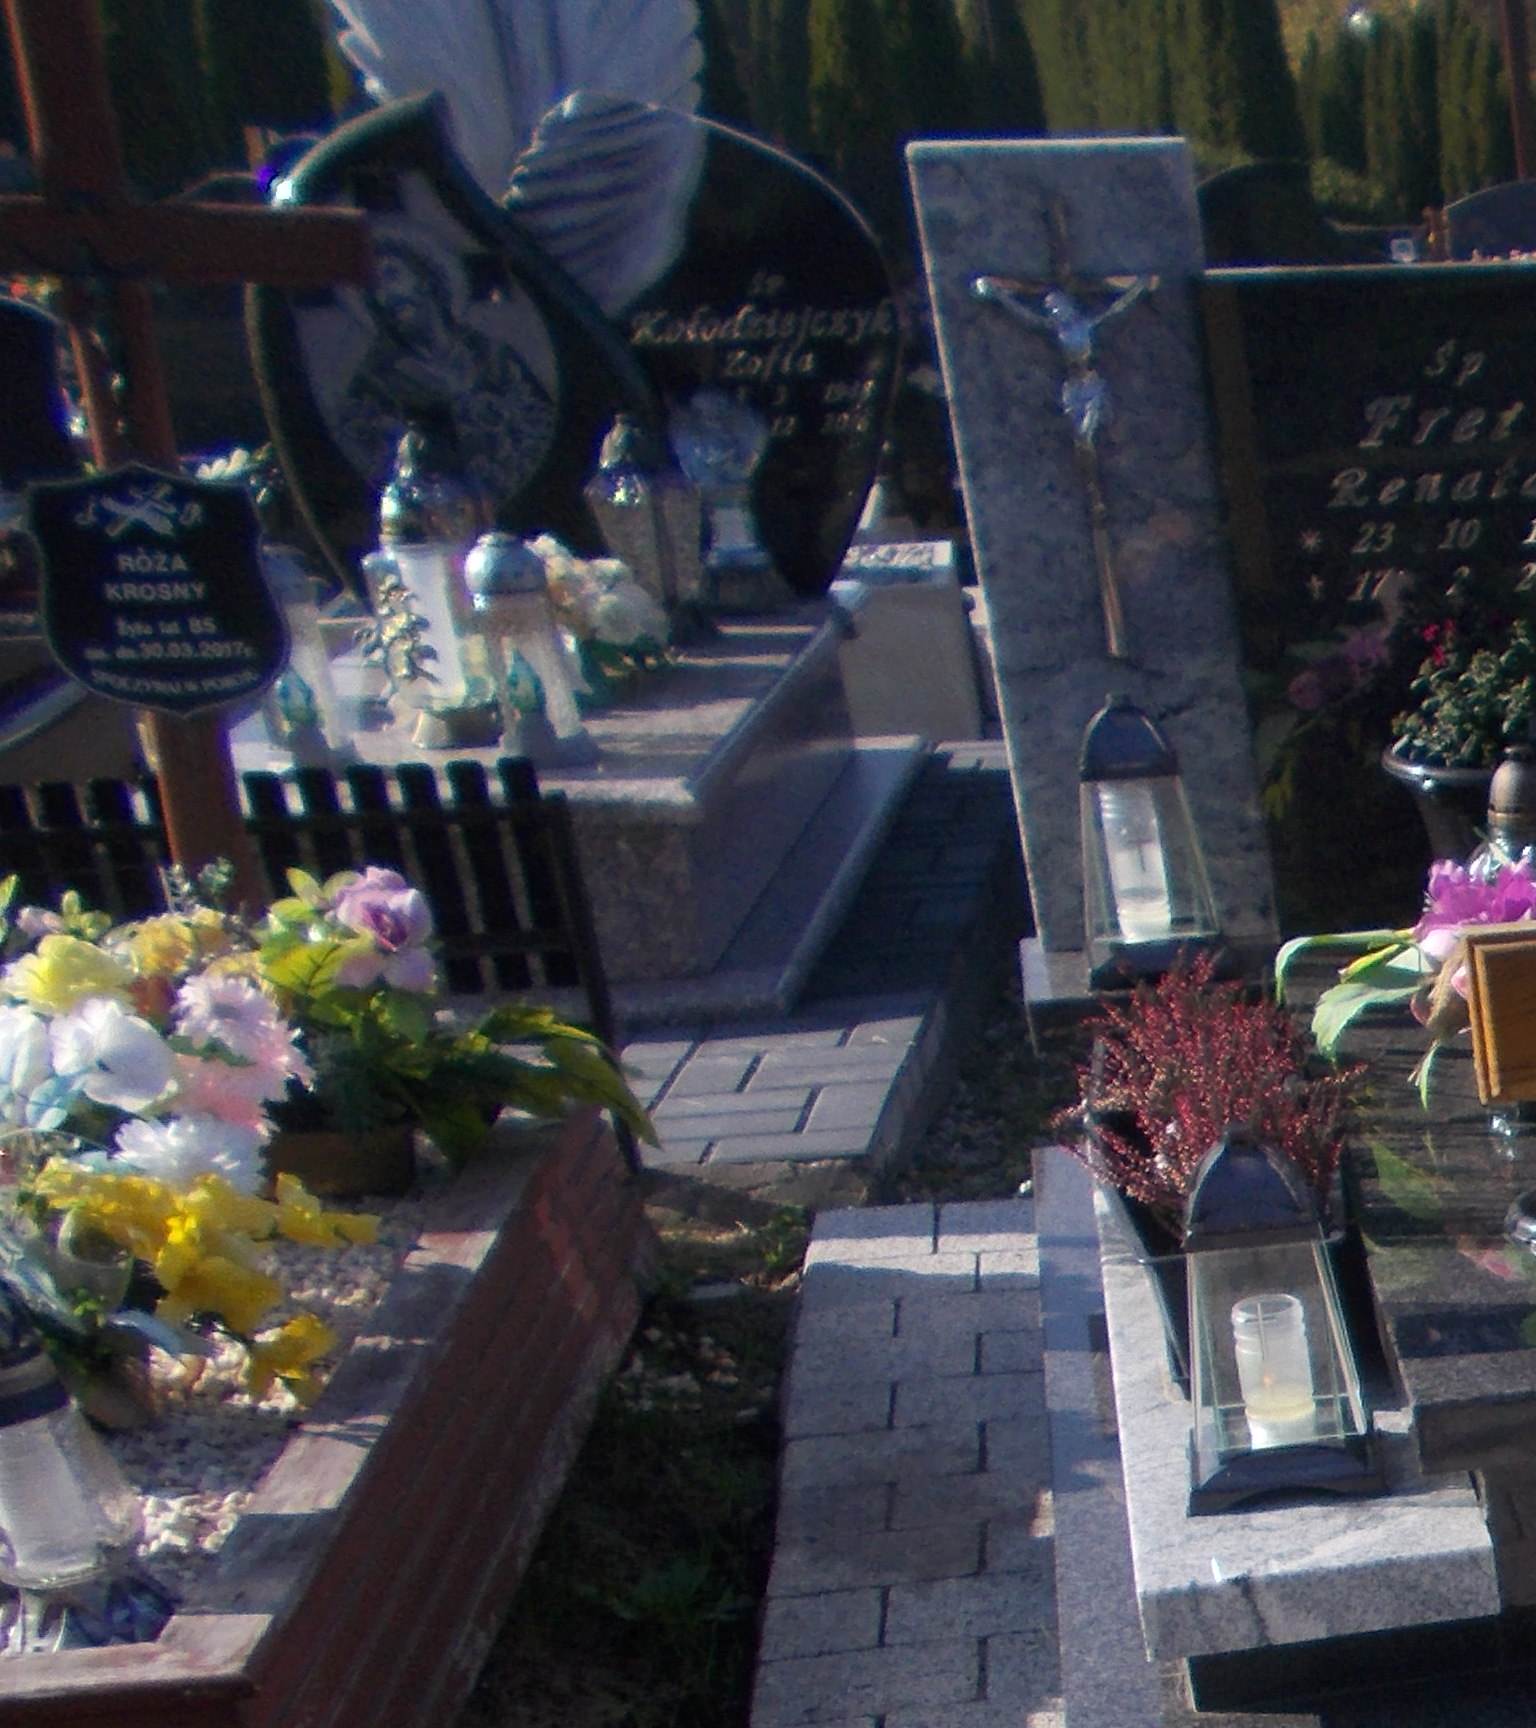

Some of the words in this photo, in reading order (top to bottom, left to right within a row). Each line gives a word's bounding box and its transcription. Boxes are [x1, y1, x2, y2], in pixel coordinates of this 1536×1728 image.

[1351, 520, 1396, 553] 23
[1438, 517, 1482, 549] 10
[117, 547, 189, 573] RÓŻA
[104, 582, 206, 602] KROSNY
